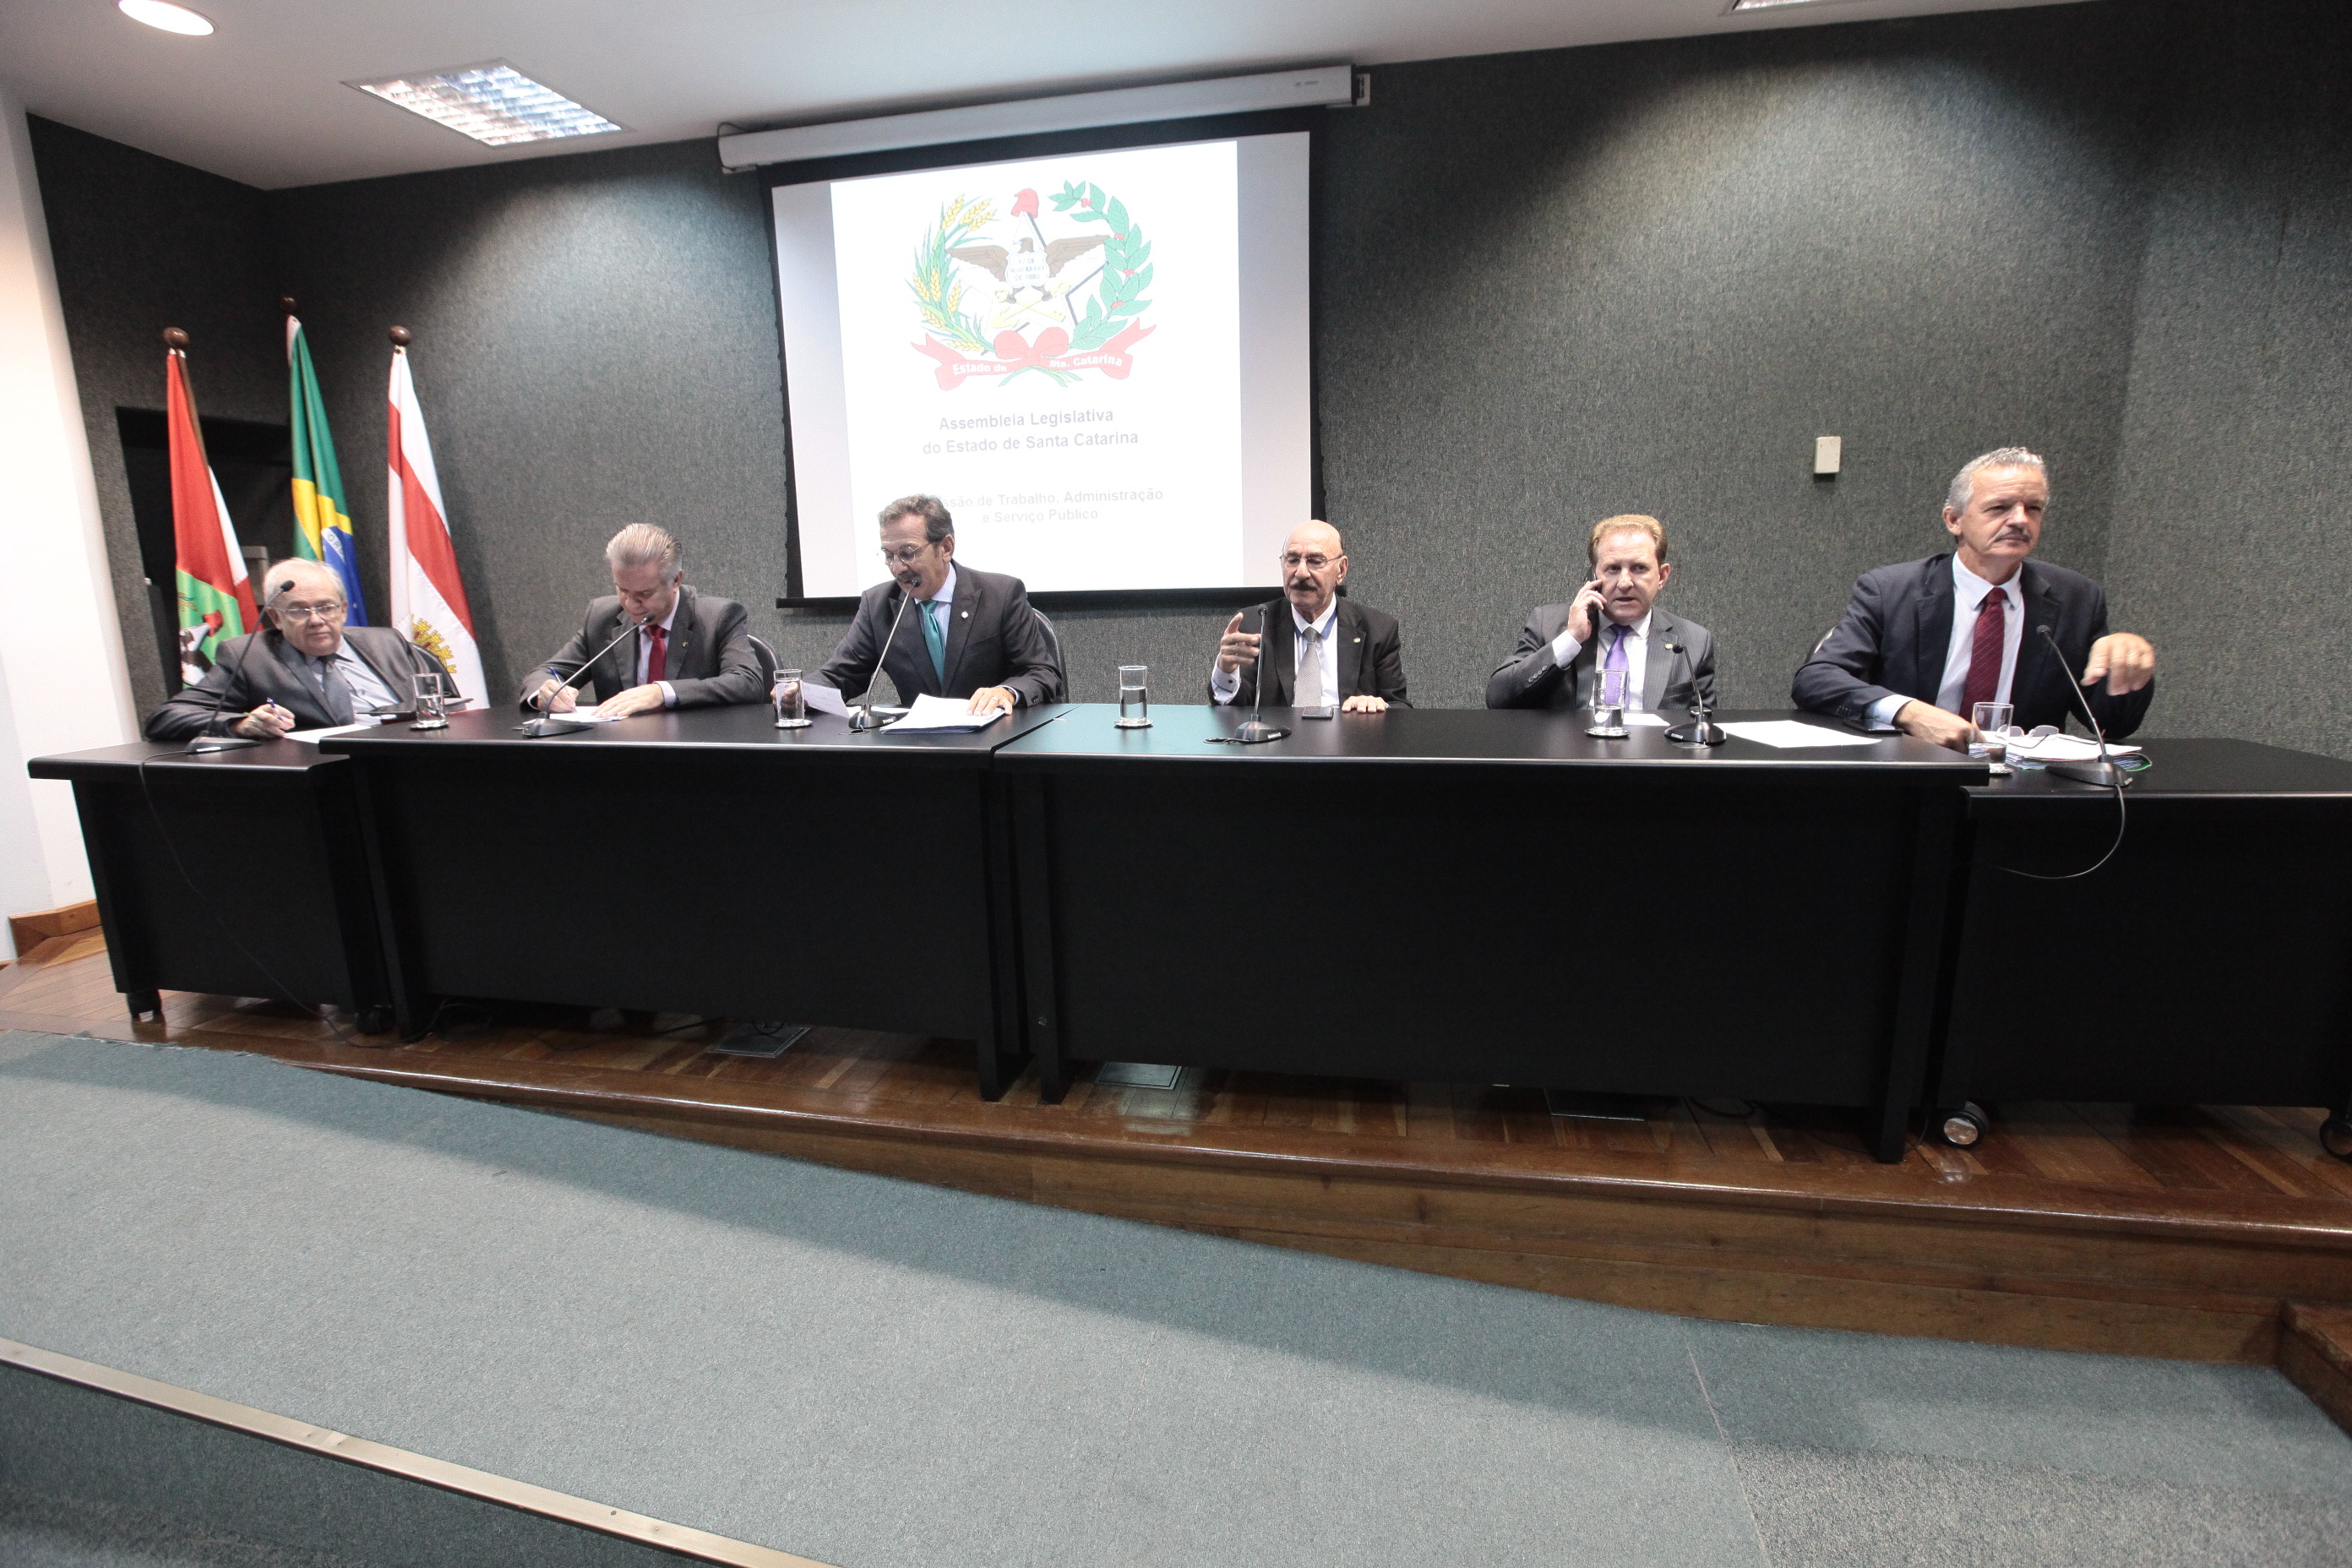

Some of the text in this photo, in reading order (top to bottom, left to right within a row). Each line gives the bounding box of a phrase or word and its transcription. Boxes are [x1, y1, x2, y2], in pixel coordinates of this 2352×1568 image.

[952, 353, 1124, 375] Estado de Sta. Catarina
[939, 409, 1113, 430] Assembleia Legislativa
[923, 430, 1139, 455] do Estado de Santa Catarina
[943, 487, 1164, 507] ssão de Trabalho, Administração
[983, 507, 1099, 524] e Serviço Público
